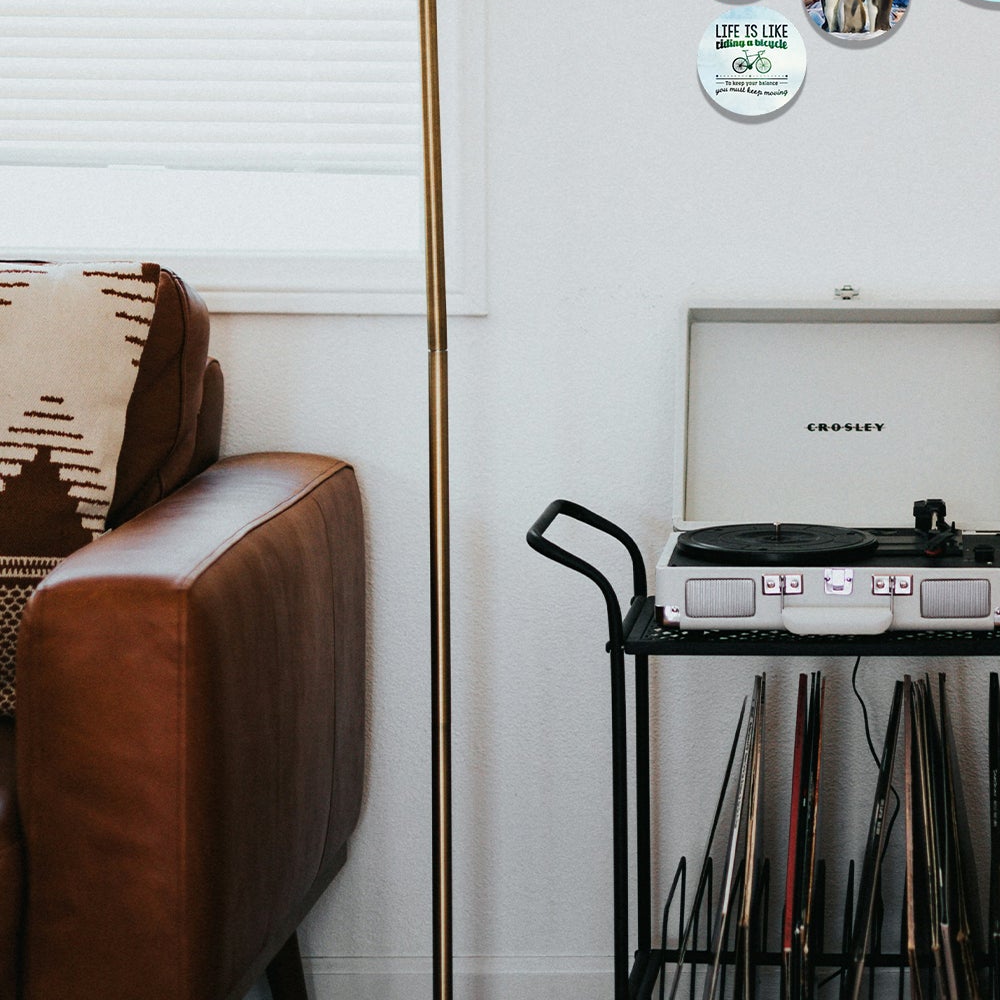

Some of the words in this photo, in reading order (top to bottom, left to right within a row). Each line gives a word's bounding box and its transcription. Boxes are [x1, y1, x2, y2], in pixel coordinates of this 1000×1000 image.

[715, 24, 740, 38] LIFE
[744, 24, 758, 38] IS
[762, 24, 788, 38] LIKE
[716, 39, 745, 50] riding
[755, 39, 788, 49] bicycle
[715, 87, 728, 95] you
[746, 87, 763, 97] keep
[806, 422, 885, 432] CROSLEY
